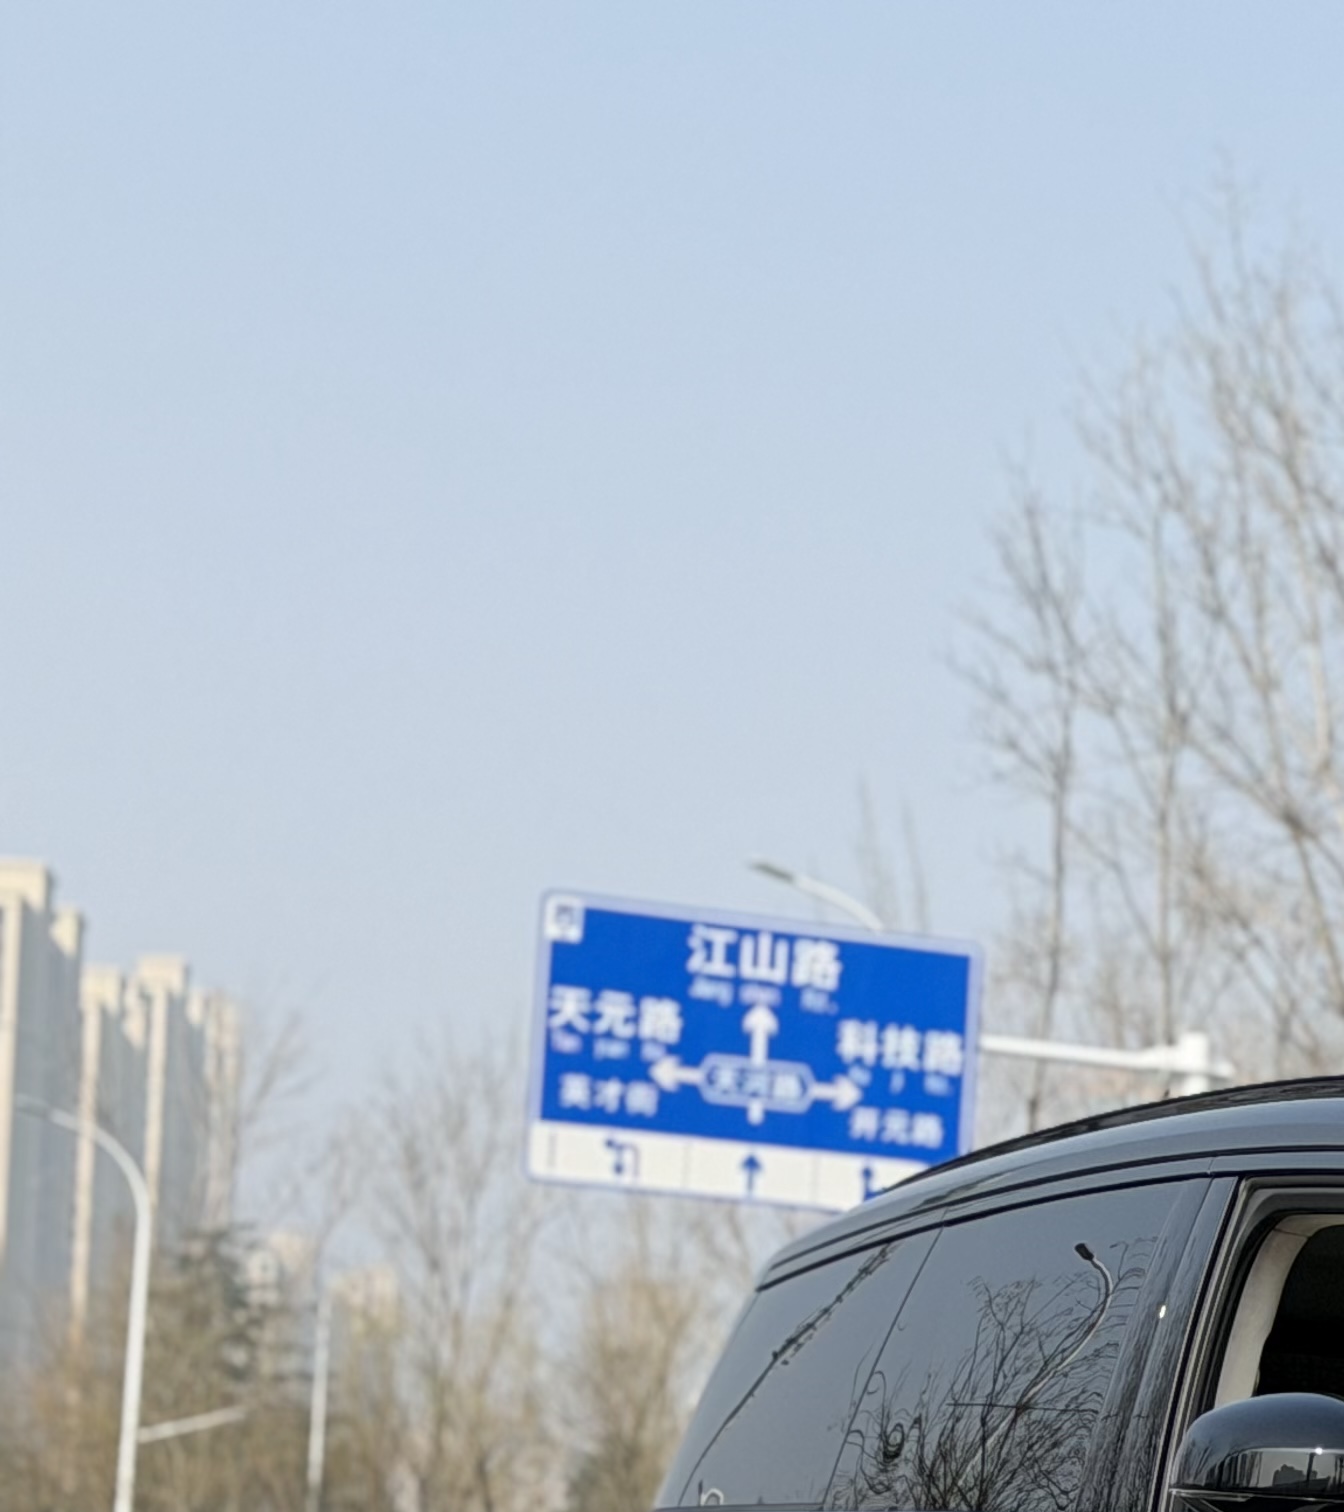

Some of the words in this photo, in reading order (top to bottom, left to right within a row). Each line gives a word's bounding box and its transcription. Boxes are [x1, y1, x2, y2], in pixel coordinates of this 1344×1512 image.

[686, 923, 842, 993] 江山路
[549, 983, 683, 1046] 天元路
